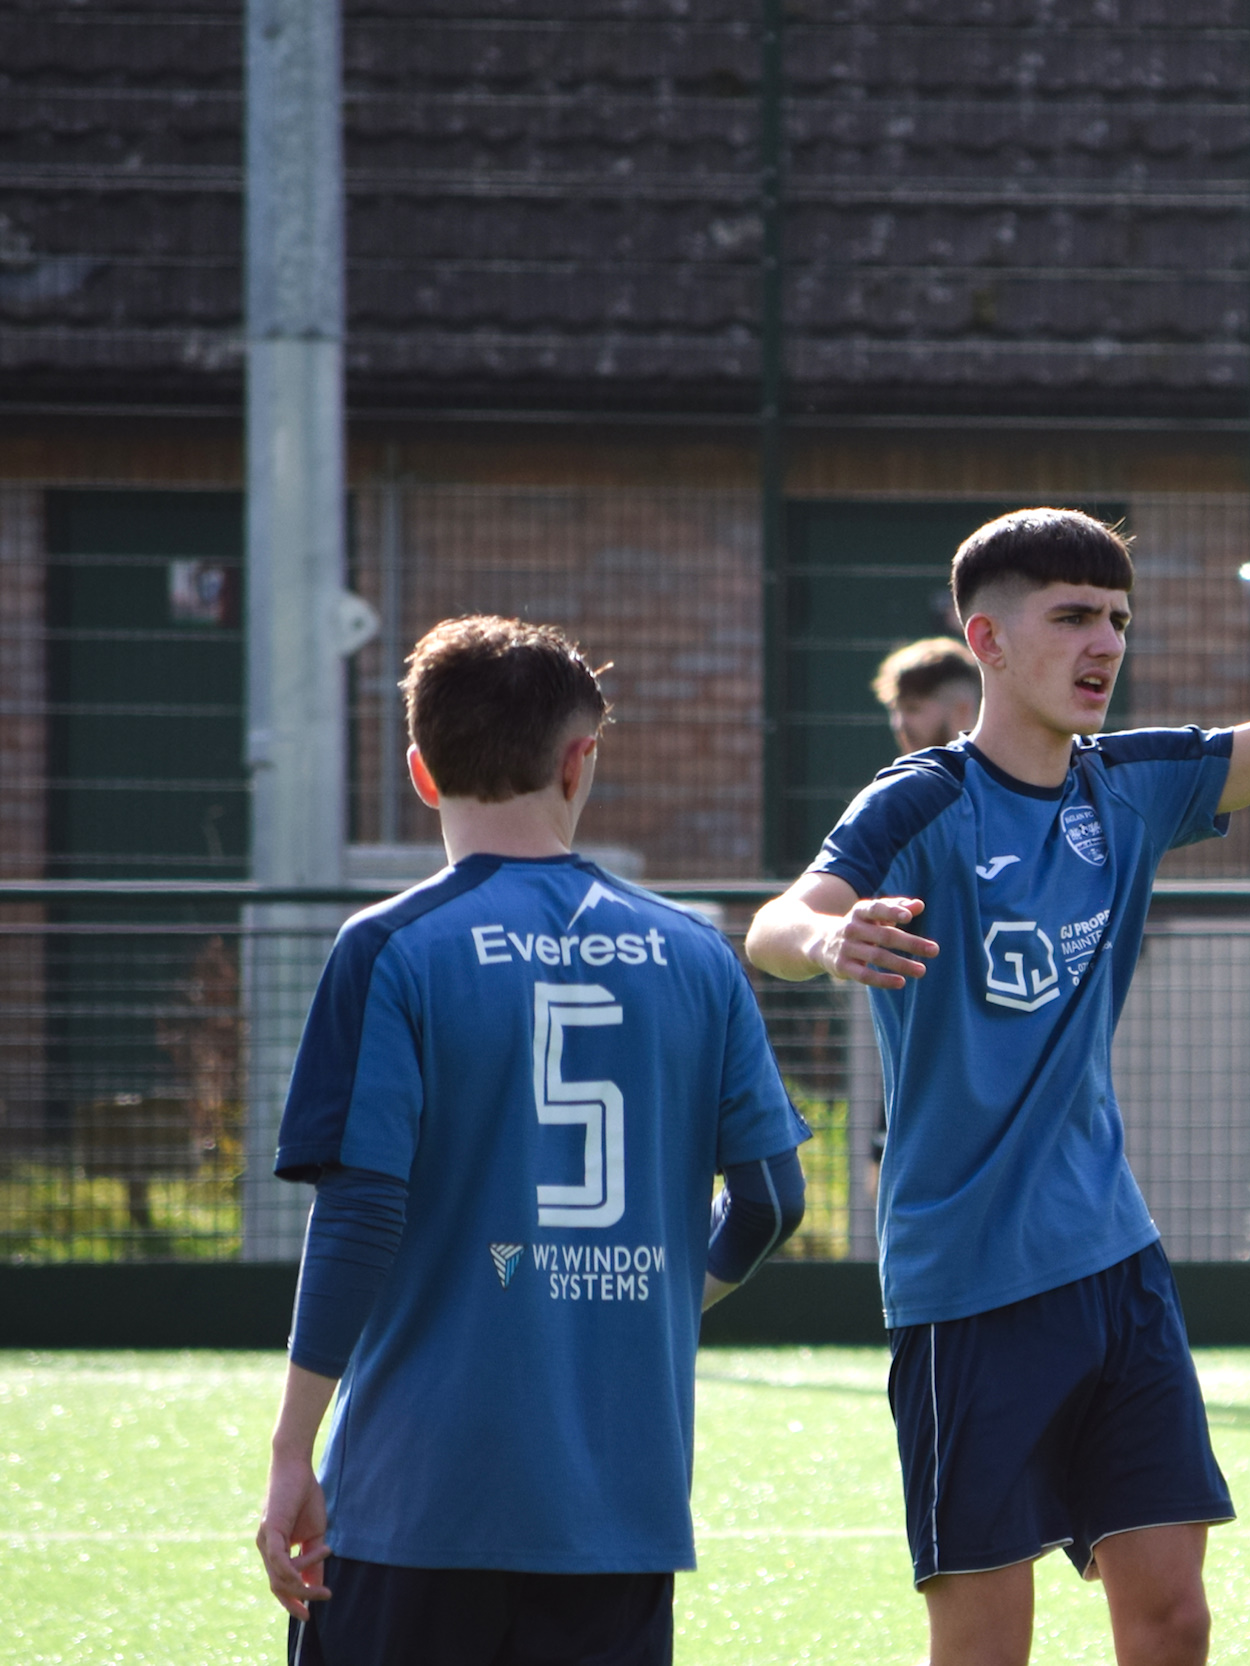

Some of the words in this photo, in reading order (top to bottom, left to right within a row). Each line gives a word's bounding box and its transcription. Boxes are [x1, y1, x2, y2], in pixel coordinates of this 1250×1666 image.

[1060, 924, 1074, 940] GJ
[1073, 909, 1110, 937] PROPE
[470, 924, 668, 967] Everest
[1061, 929, 1103, 956] MAINTE
[532, 980, 627, 1229] 5
[532, 1244, 559, 1271] W2
[561, 1245, 666, 1273] WINDOW
[549, 1272, 650, 1301] SYSTEMS
